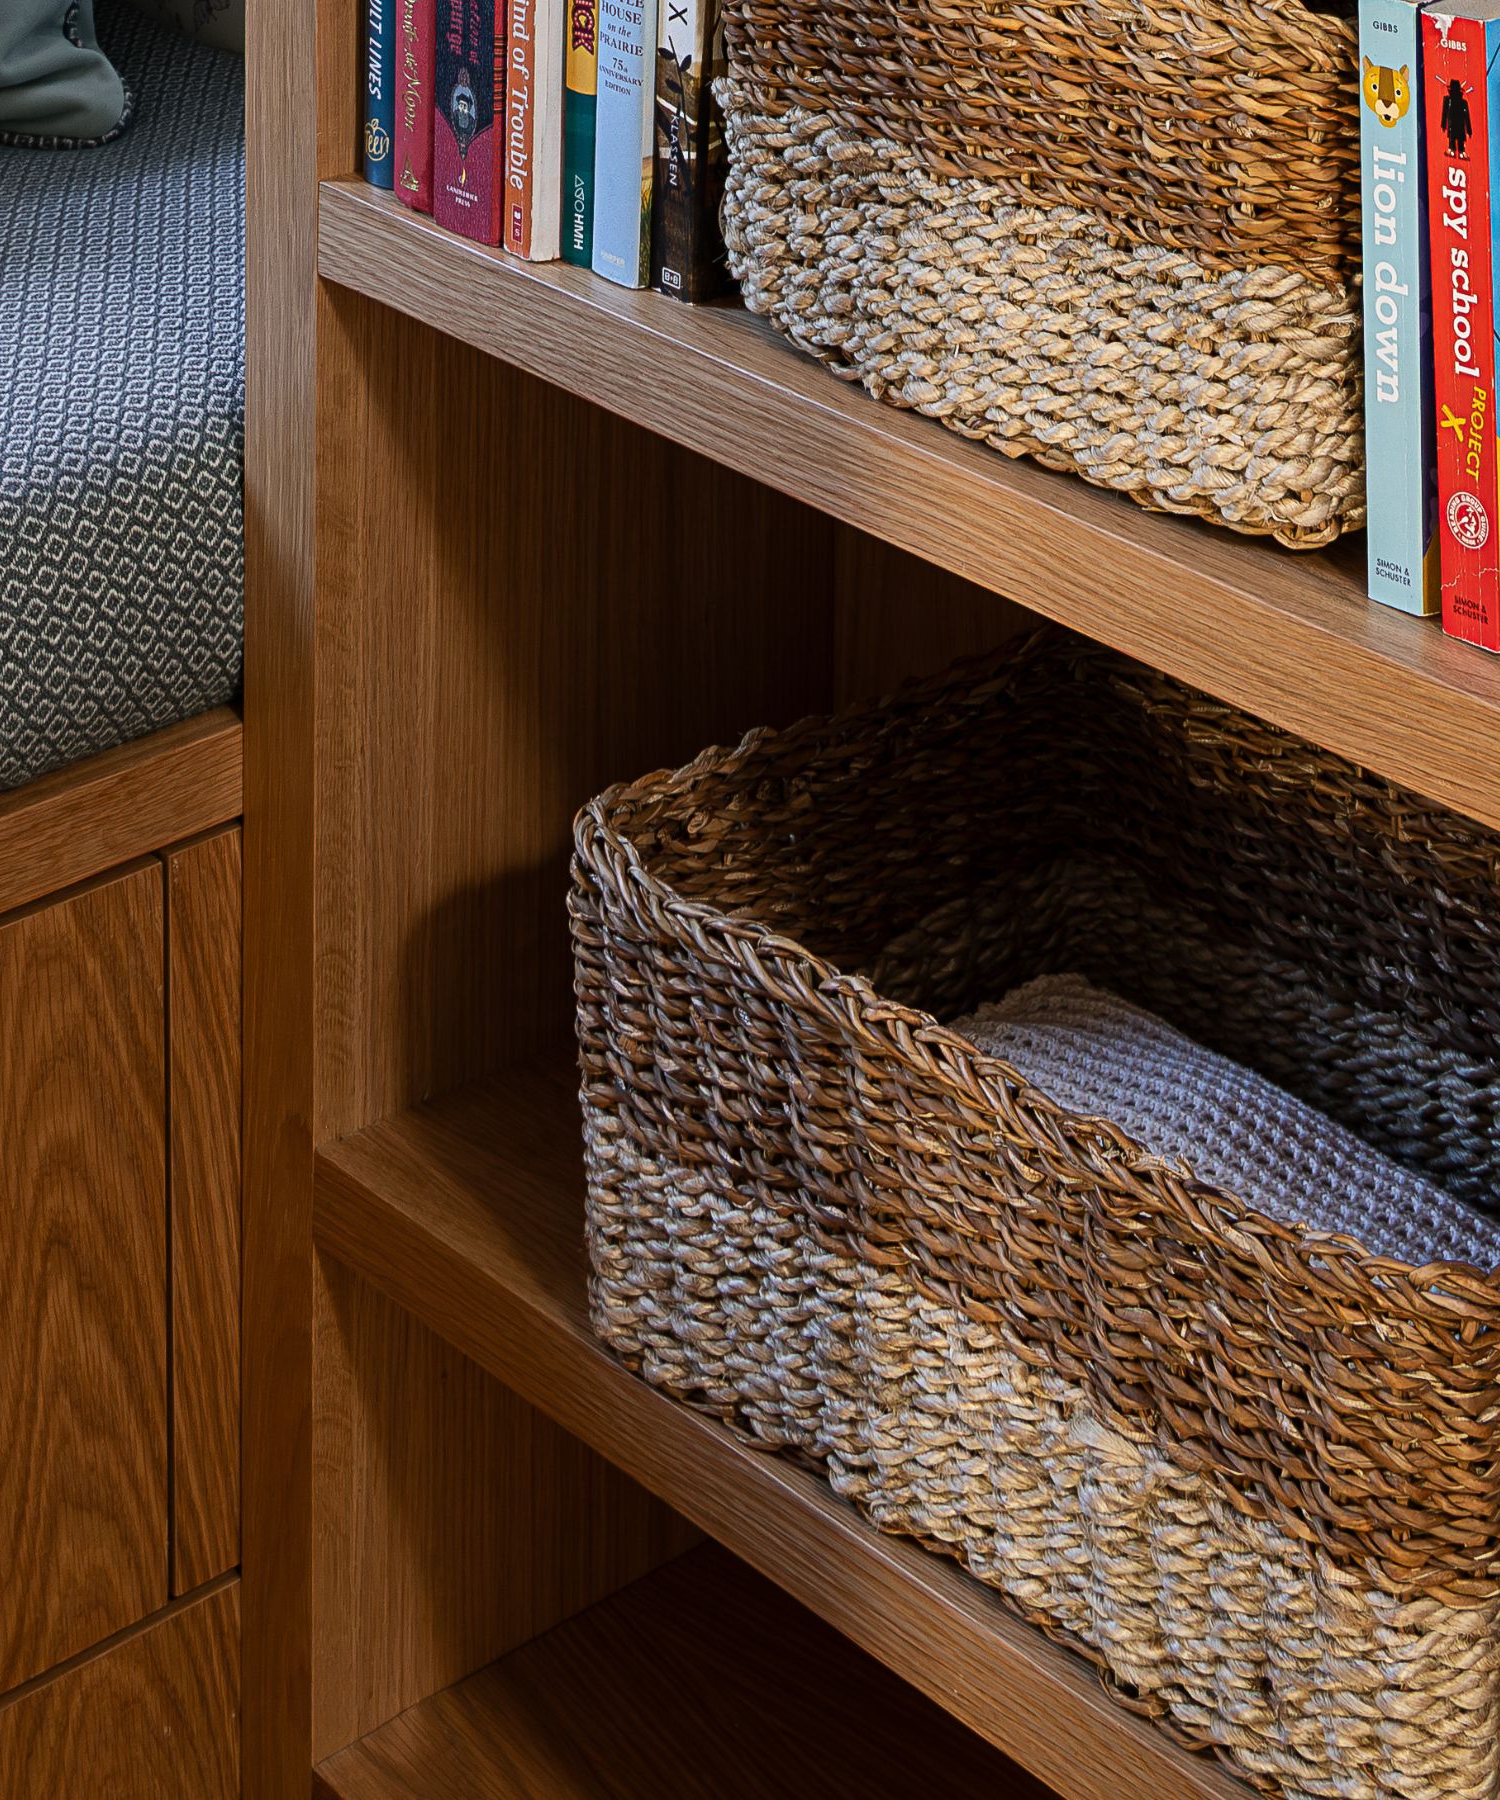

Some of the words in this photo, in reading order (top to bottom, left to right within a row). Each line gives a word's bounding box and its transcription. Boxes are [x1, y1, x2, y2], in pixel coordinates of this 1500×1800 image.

[601, 0, 642, 25] HOUSE
[608, 23, 616, 33] on
[618, 24, 631, 39] the
[599, 33, 643, 57] PRAIRIE
[1440, 166, 1469, 243] spy
[1450, 248, 1482, 377] school
